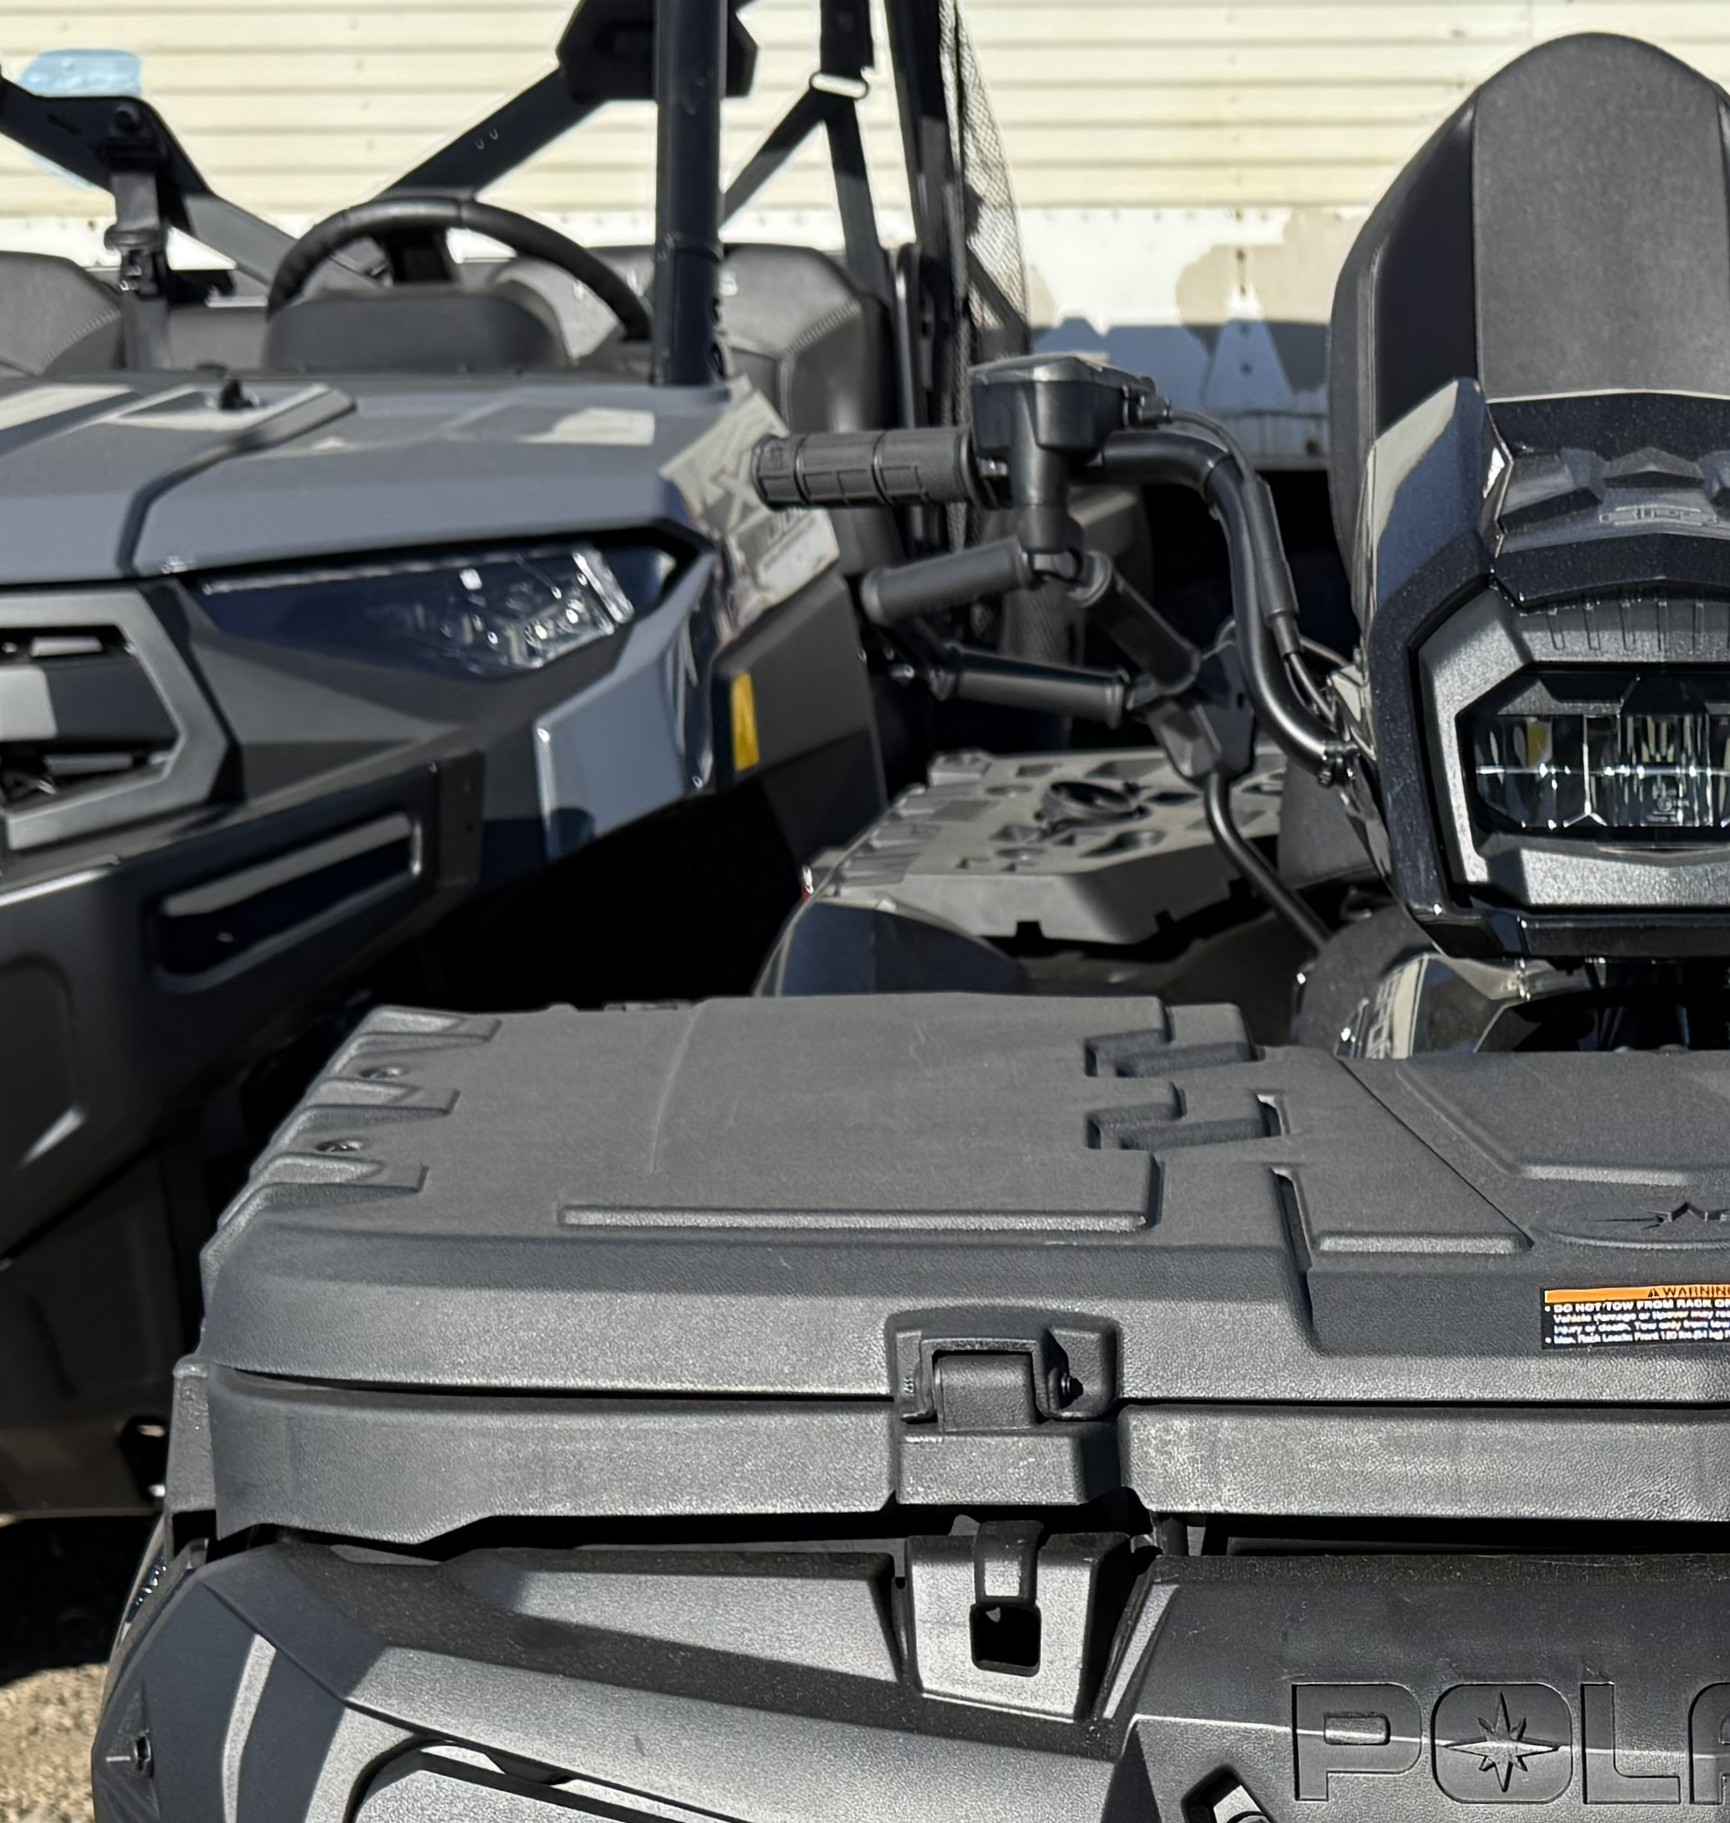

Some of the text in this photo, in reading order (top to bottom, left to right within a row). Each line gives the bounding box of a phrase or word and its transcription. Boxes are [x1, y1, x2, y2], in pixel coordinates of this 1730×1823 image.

[1553, 1303, 1574, 1314] DO
[1575, 1302, 1601, 1313] NOT
[1603, 1301, 1634, 1312] TOW
[1636, 1300, 1674, 1310] FROM
[1676, 1299, 1713, 1309] RACK
[1553, 1312, 1592, 1324] Vehicle
[1594, 1312, 1637, 1324] damage
[1638, 1311, 1651, 1320] or
[1690, 1310, 1714, 1320] may
[1584, 1324, 1597, 1333] or
[1633, 1321, 1657, 1331] Tow
[1658, 1320, 1681, 1331] only
[1683, 1319, 1709, 1329] from
[1710, 1320, 1730, 1329] tow
